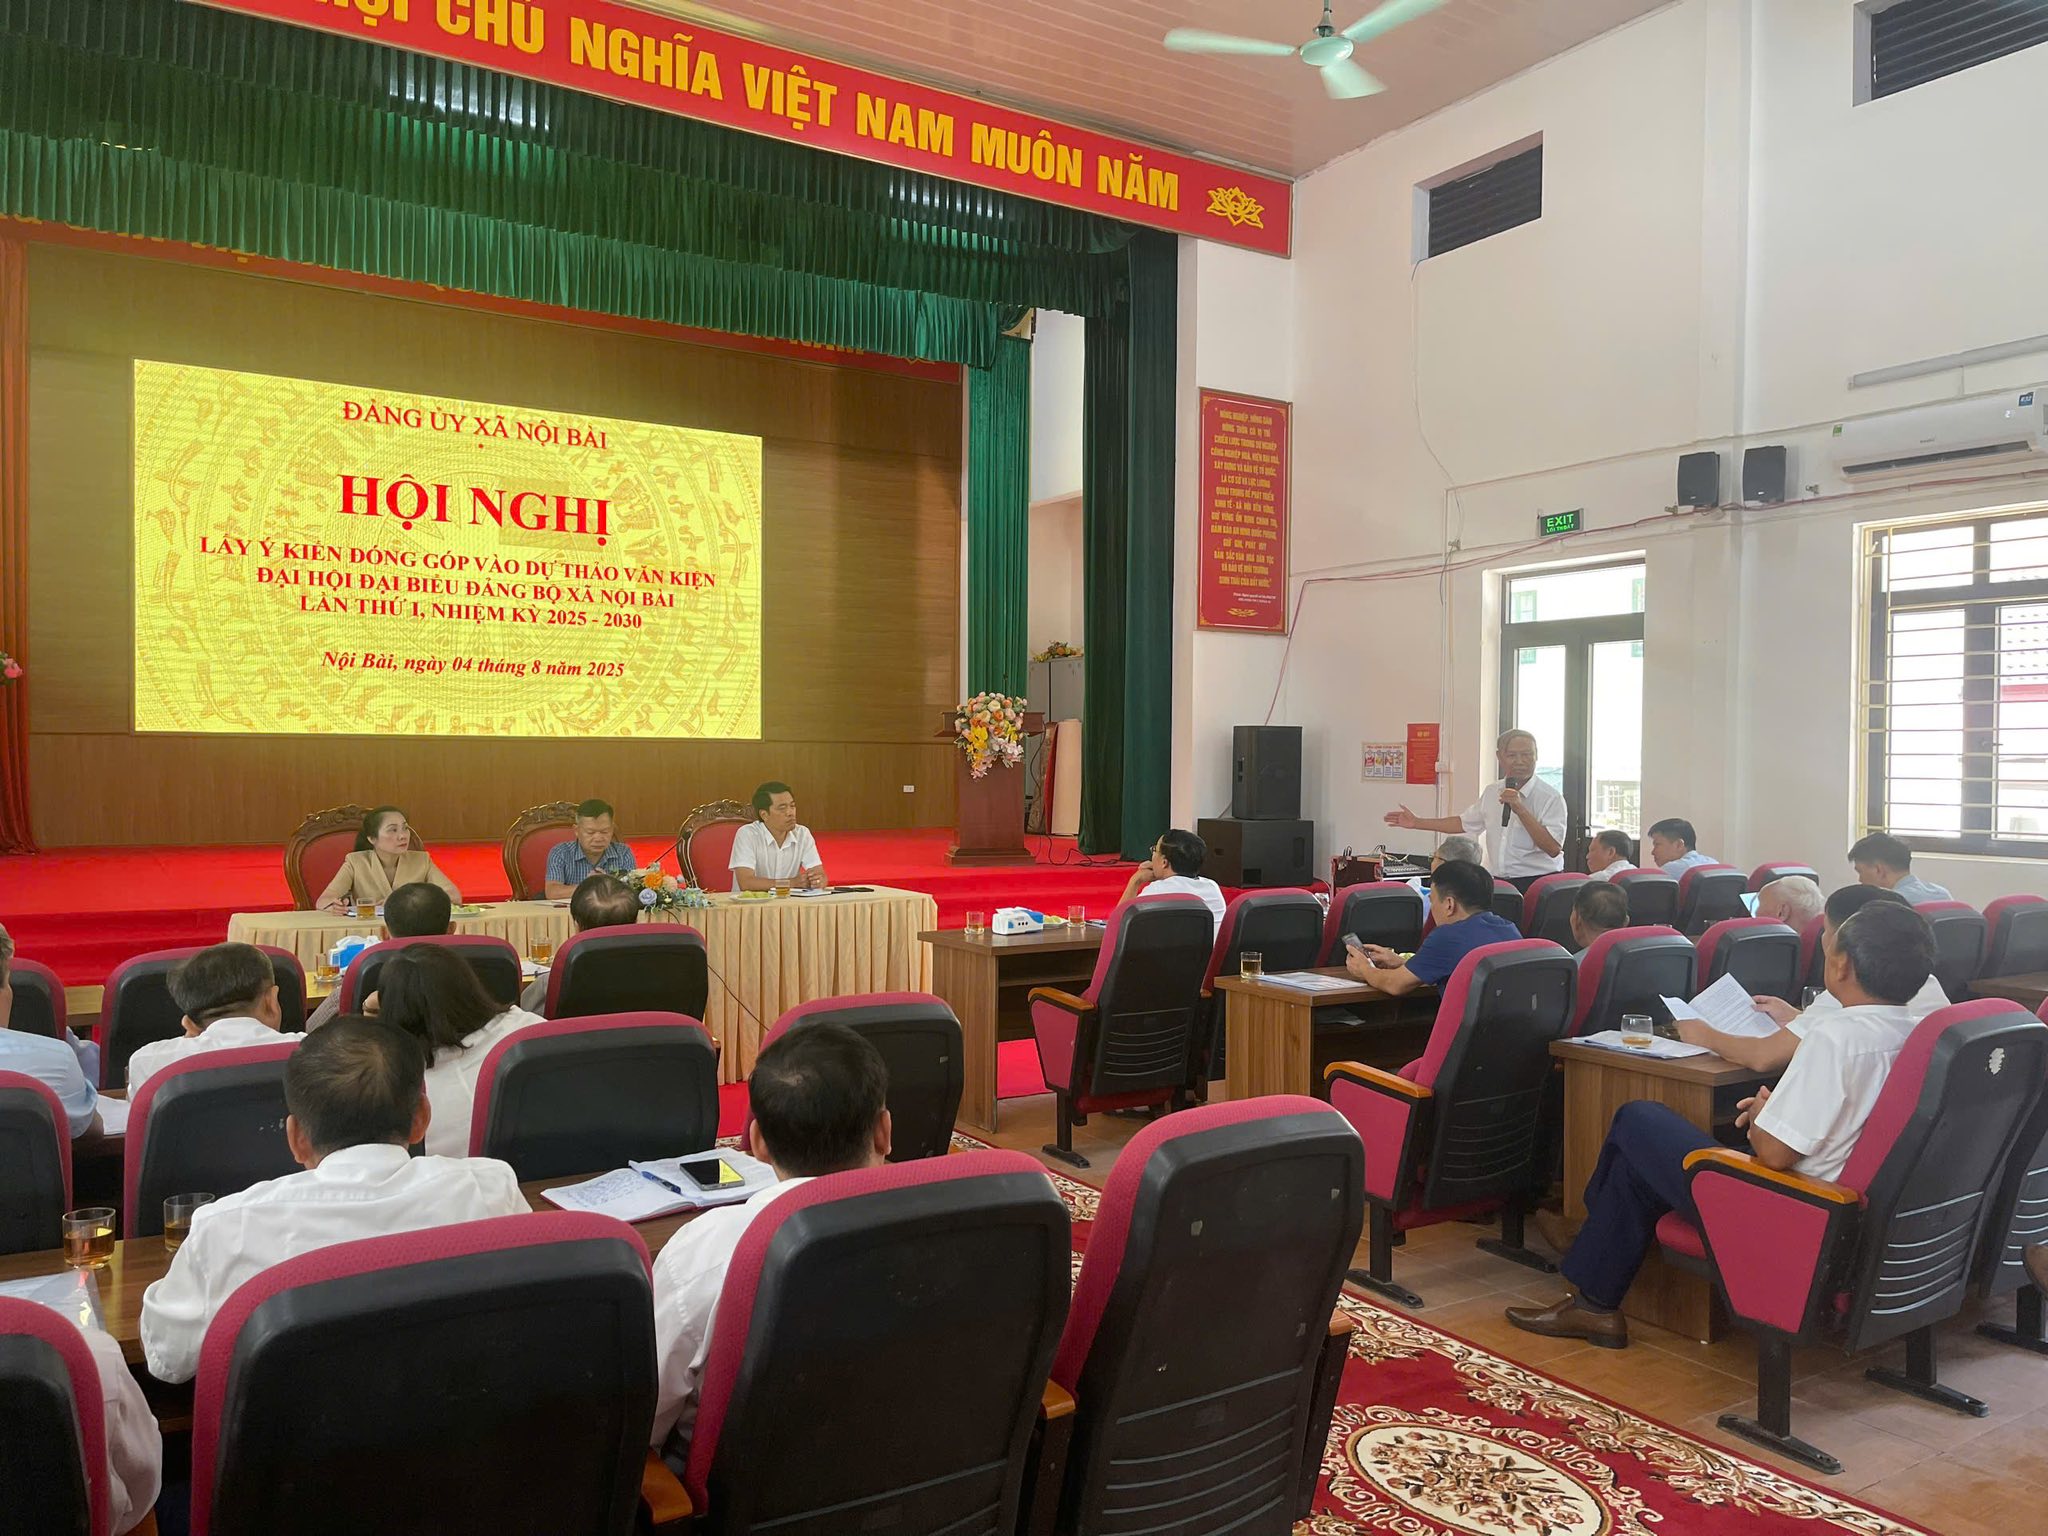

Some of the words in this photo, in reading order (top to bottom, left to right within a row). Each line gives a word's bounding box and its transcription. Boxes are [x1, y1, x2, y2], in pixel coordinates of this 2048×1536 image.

[571, 19, 723, 100] NGHĨA
[743, 63, 838, 130] VIỆT
[857, 93, 954, 157] NAM
[972, 124, 1082, 188] MUÔN
[1098, 152, 1178, 211] NĂM
[343, 399, 423, 429] ĐẢNG
[430, 406, 466, 433] ỦY
[474, 415, 510, 439] XÃ
[517, 419, 560, 447] NỘI
[567, 425, 608, 450] BÀI
[337, 473, 453, 531] HỘI
[468, 486, 612, 547] NGHỊ
[1546, 514, 1574, 527] EXIT
[259, 536, 276, 558] Ý
[350, 544, 417, 568] ĐÓNG
[423, 550, 470, 573] GÓP
[474, 554, 520, 576] VÀO
[526, 558, 558, 580] DỰ
[561, 559, 619, 582] THẢO
[624, 565, 665, 585] VĂN
[670, 570, 717, 590] KIỆN
[257, 567, 300, 589] ĐẠI
[308, 569, 352, 592] HỘI
[359, 573, 400, 595] ĐẠI
[467, 577, 526, 600] ĐẢNG
[533, 582, 562, 607] BỘ
[567, 587, 595, 604] XÃ
[601, 588, 636, 609] NỘI
[642, 588, 675, 608] BÀI
[300, 592, 348, 614] LẦN
[355, 596, 406, 616] THỨ
[411, 602, 426, 620] I,
[432, 602, 505, 625] NHIỆM
[512, 604, 541, 624] KỲ
[547, 609, 587, 627] 2025
[603, 612, 643, 629] 2030
[322, 651, 356, 671] Nội
[362, 652, 398, 671] Bài,
[404, 654, 447, 675] ngày
[452, 656, 472, 672] 04
[477, 658, 526, 678] tháng
[531, 660, 542, 675] 8
[546, 660, 582, 677] năm
[587, 662, 625, 678] 2025
